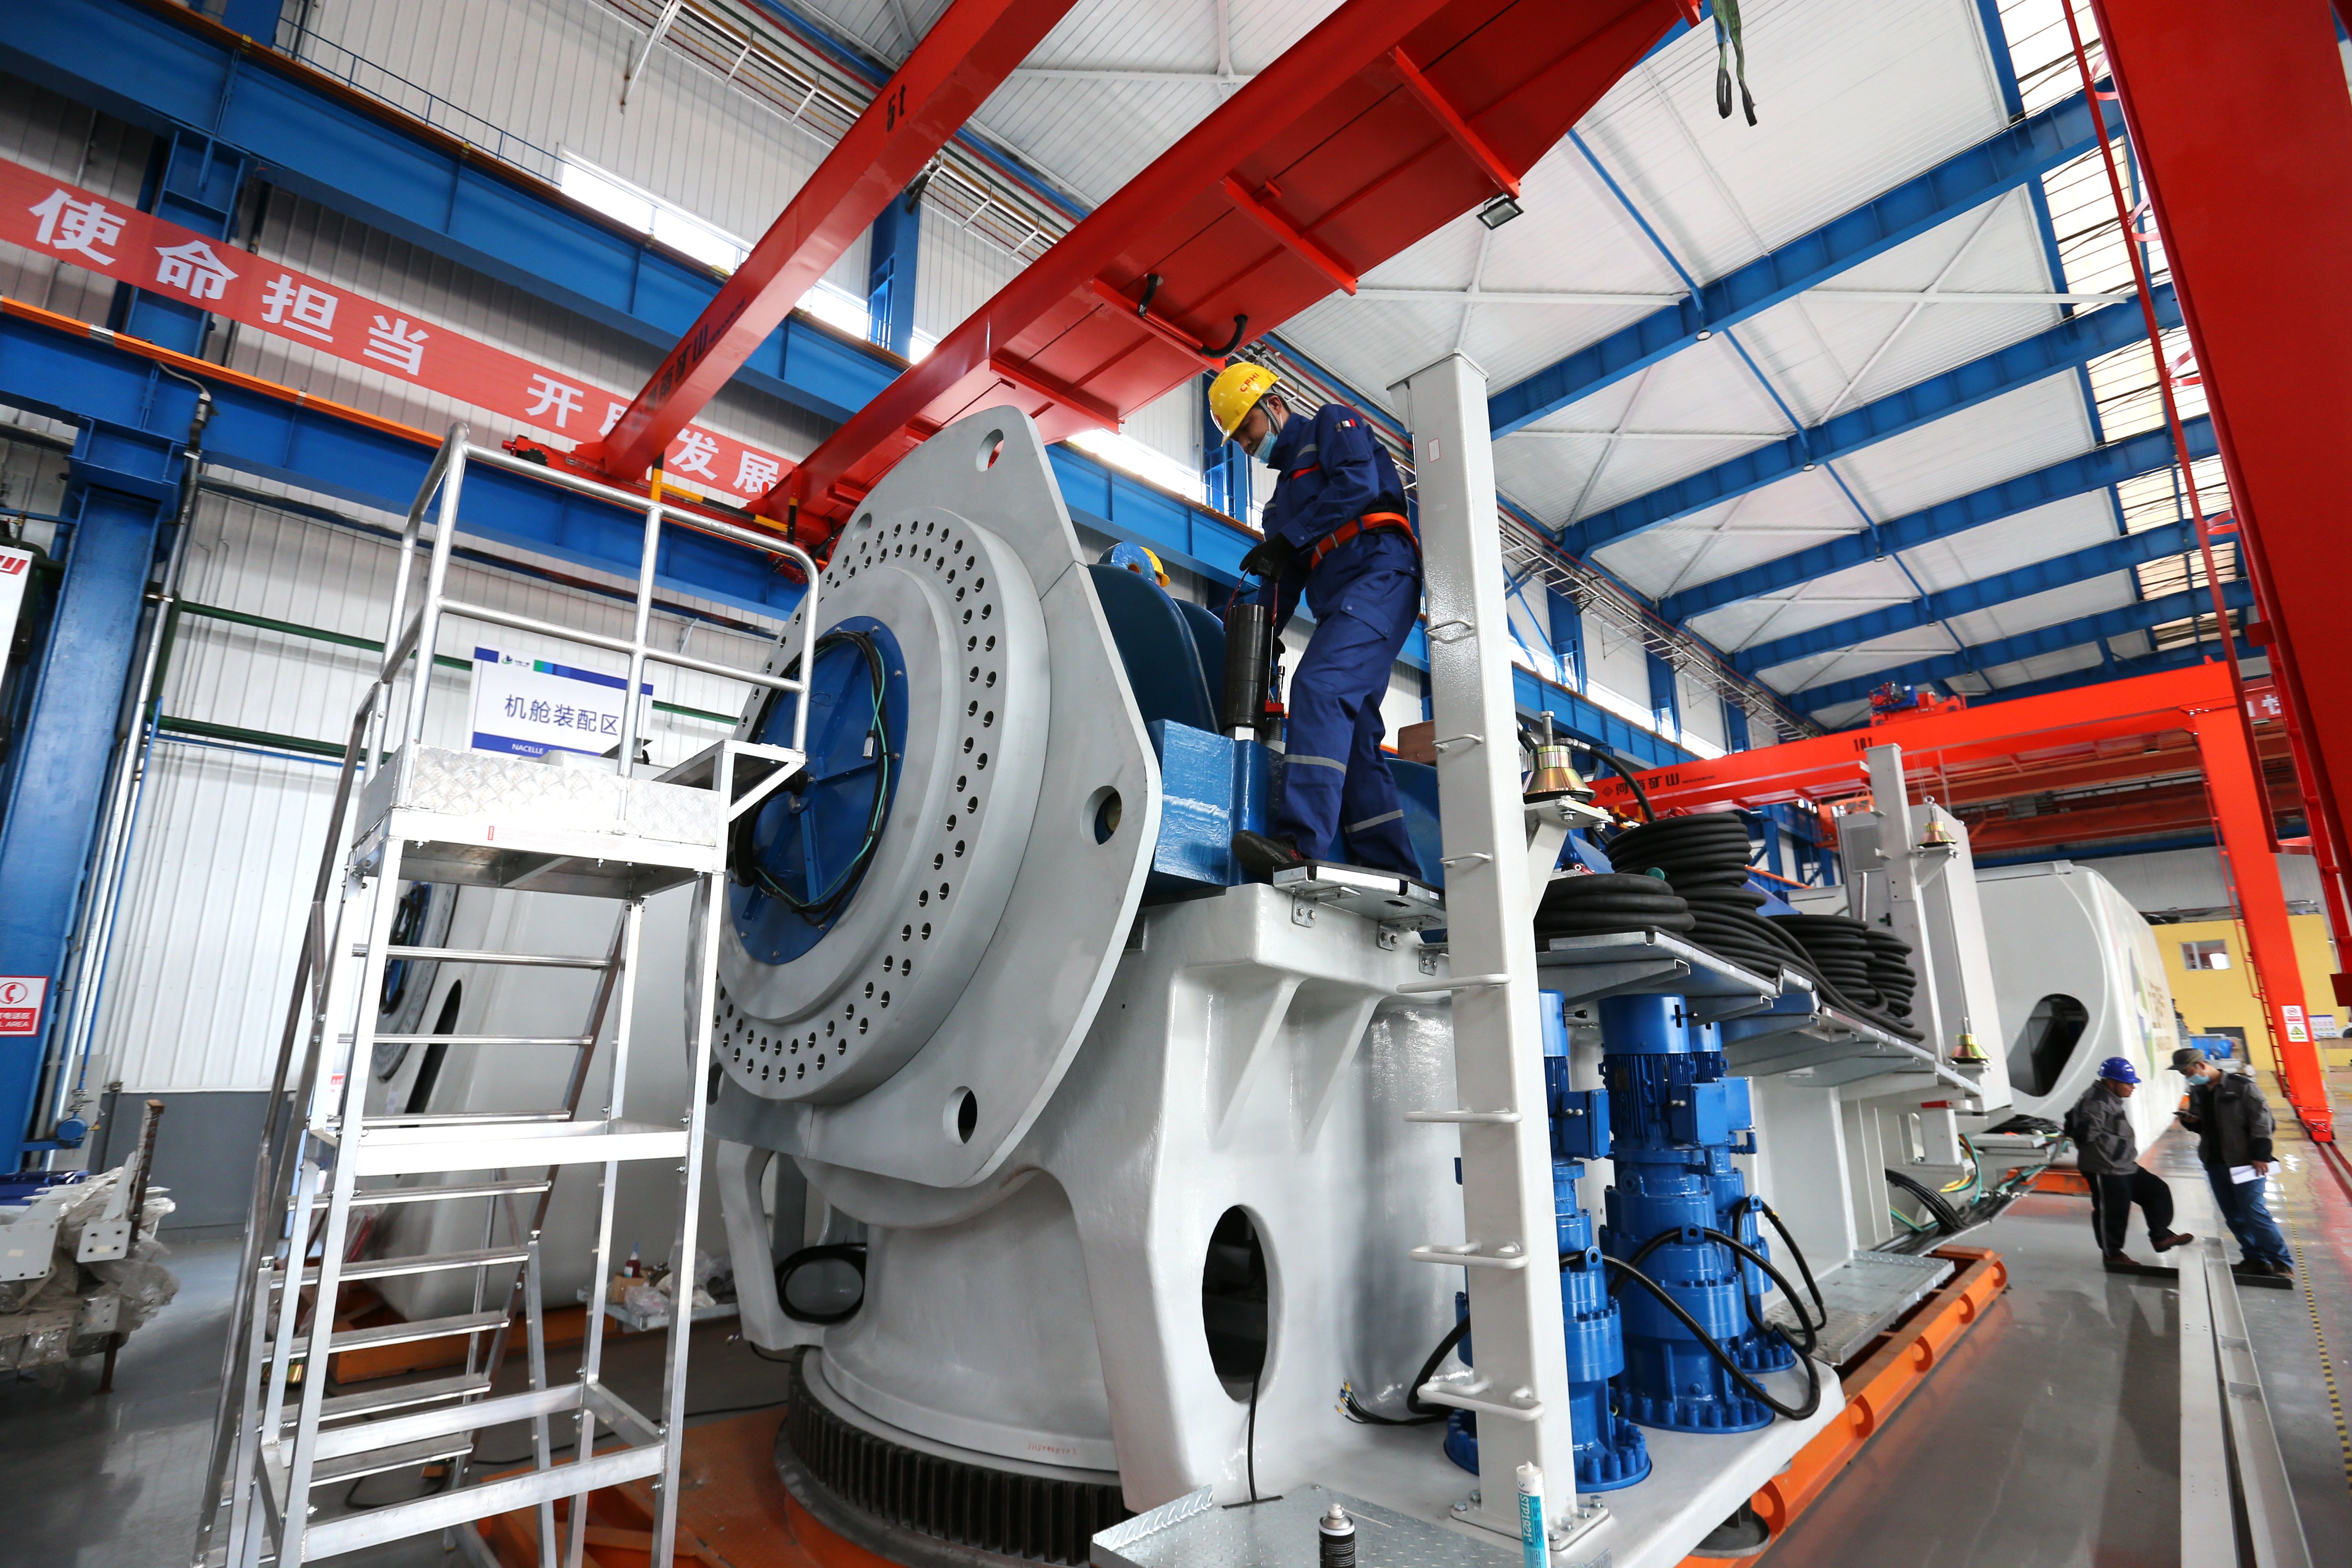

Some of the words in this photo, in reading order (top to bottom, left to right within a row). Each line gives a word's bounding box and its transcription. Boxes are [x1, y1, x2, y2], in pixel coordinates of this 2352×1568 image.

[29, 189, 429, 376] 使命担当
[1240, 372, 1260, 392] CFHI
[505, 694, 619, 735] 机舱装配区
[512, 744, 544, 755] NACELLE
[1854, 737, 1872, 751] 10t
